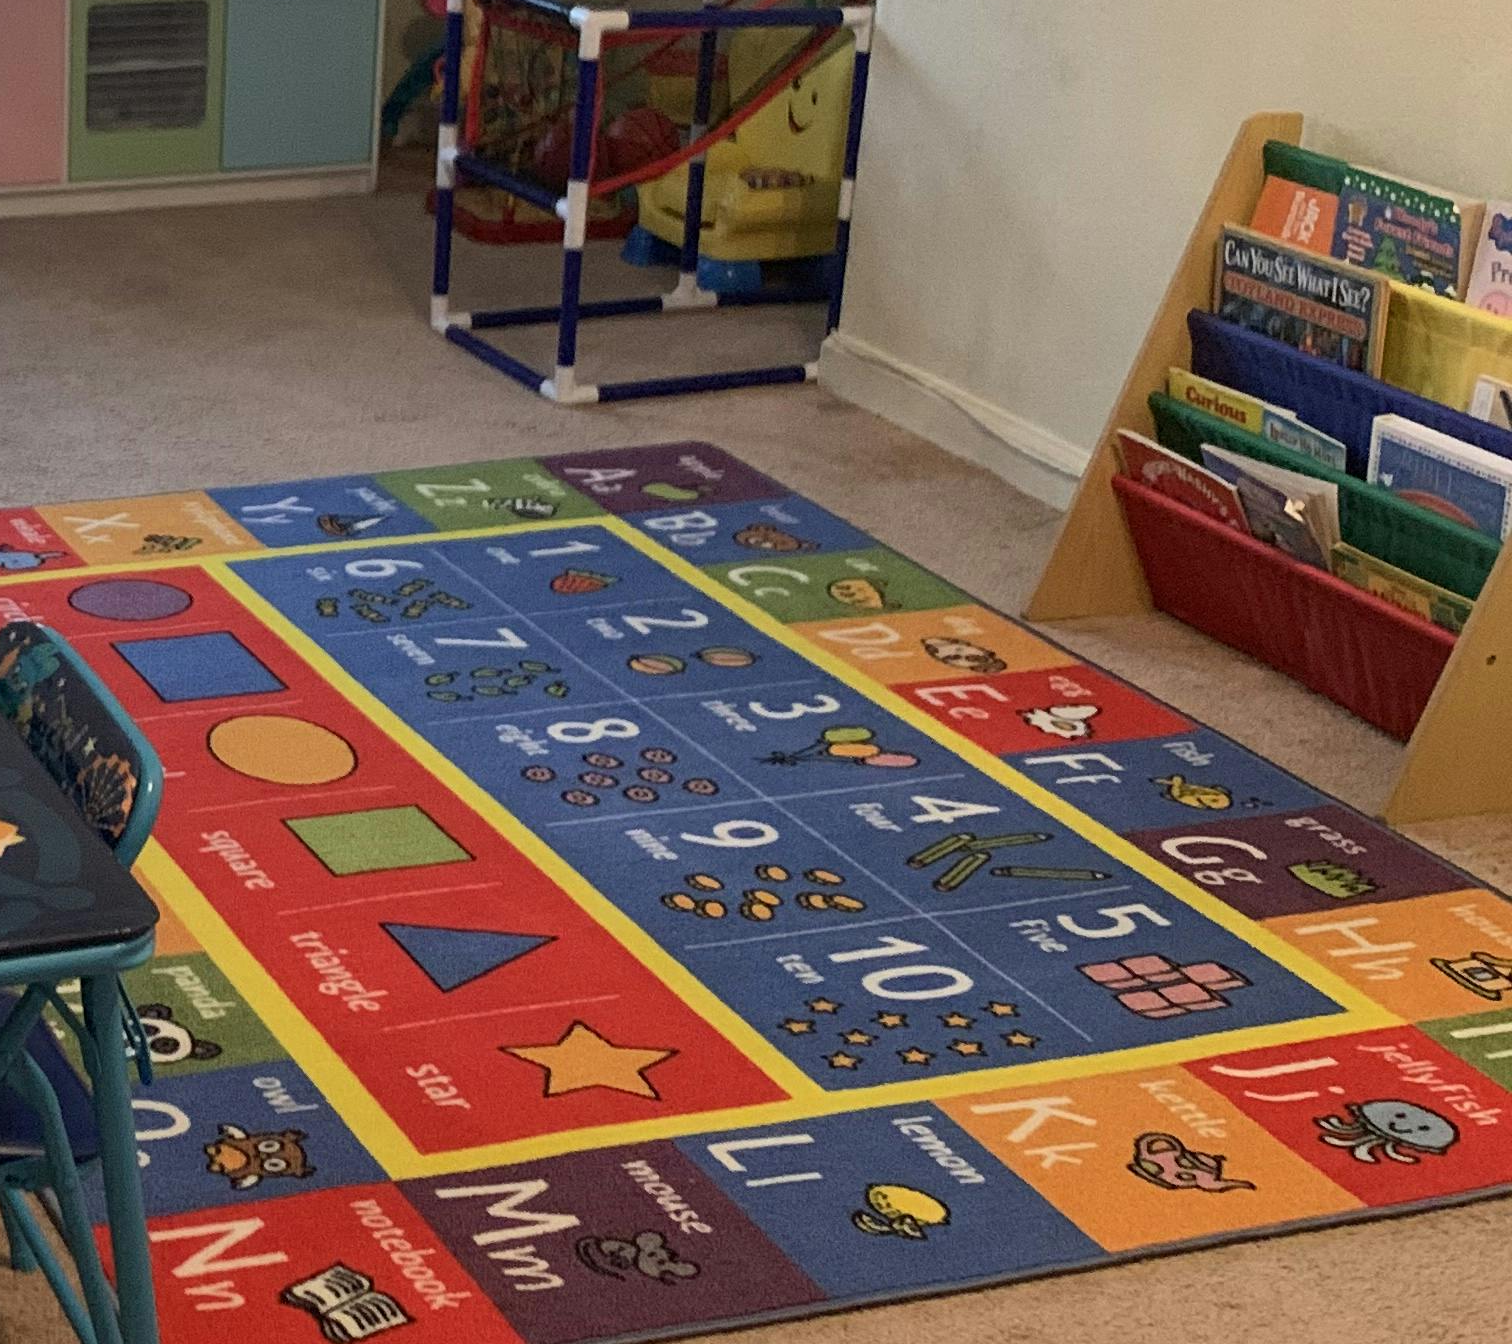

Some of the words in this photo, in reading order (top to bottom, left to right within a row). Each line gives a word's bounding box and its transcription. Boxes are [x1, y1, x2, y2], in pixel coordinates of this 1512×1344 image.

[1185, 386, 1247, 424] Curious
[529, 540, 599, 556] 1
[344, 558, 422, 577] 6
[434, 627, 528, 648] 7
[622, 609, 708, 634] 2
[748, 694, 840, 719] 3
[914, 683, 1009, 719] Ee
[546, 718, 639, 743] 8
[1023, 752, 1123, 783] Ff
[849, 802, 902, 831] four
[910, 795, 1000, 823] 4
[625, 828, 678, 859] nine
[680, 819, 779, 847] 9
[1283, 816, 1367, 854] grass
[198, 829, 275, 889] square
[1160, 835, 1267, 885] Gg
[1009, 919, 1068, 952] five
[1056, 903, 1171, 938] 5
[775, 953, 824, 983] ten
[828, 936, 974, 1000] 10
[1295, 917, 1417, 981] Hh
[289, 930, 387, 1011] triangle
[151, 965, 235, 1019] panda
[252, 1076, 318, 1113] owl
[405, 1063, 470, 1108] star
[1356, 1042, 1503, 1125] jellyfish
[1138, 1079, 1226, 1138] kettle
[891, 1115, 985, 1183] lemon
[971, 1096, 1099, 1169] Kk
[621, 1159, 712, 1233] mouse
[435, 1178, 580, 1290] Mm
[148, 1216, 289, 1312] Nn
[350, 1199, 464, 1309] notebook
